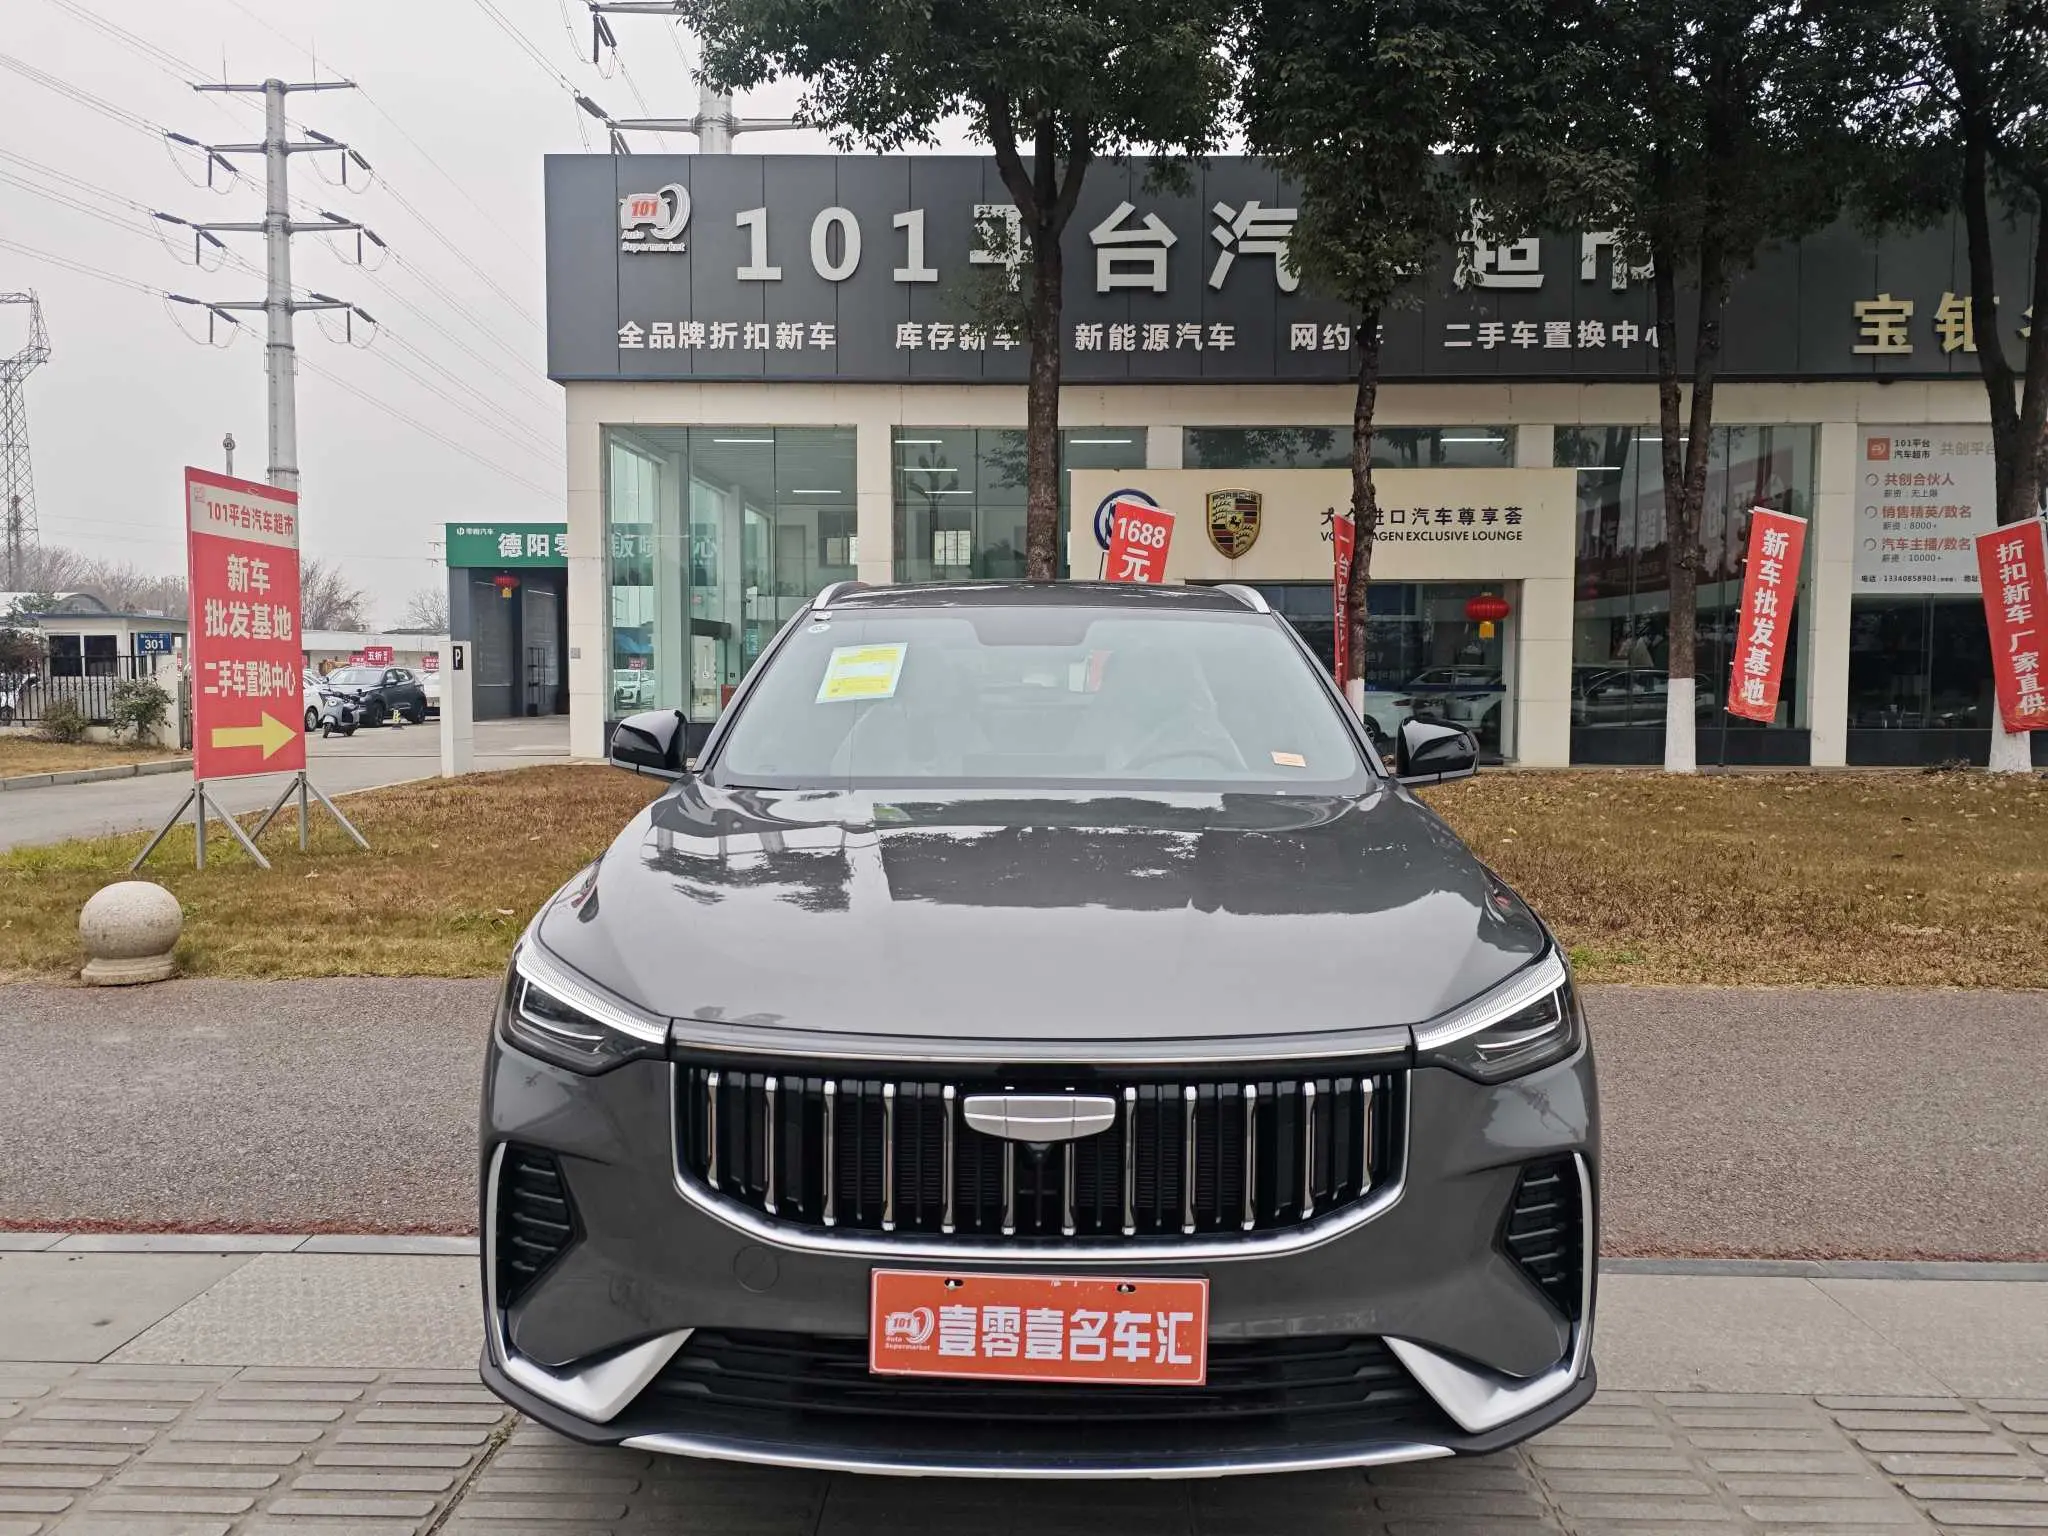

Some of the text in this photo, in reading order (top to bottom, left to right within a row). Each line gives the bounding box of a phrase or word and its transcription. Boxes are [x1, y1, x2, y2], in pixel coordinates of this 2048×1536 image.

[632, 201, 658, 216] 101
[735, 199, 1656, 293] 101平台汽超市
[617, 320, 837, 350] 全品牌折扣新车
[1074, 323, 1237, 351] 新能源汽车
[1884, 472, 1955, 486] 共创合伙人
[1212, 491, 1258, 502] PORSCHE
[207, 501, 294, 537] 101平台汽车超市
[1320, 506, 1523, 526] 大口汽车尊享荟
[1117, 517, 1167, 549] 1688
[1320, 530, 1523, 541] VOAGEN EXCLUSIVE LOUNGE
[227, 553, 271, 596] 新车
[1118, 547, 1151, 582] 元
[204, 598, 293, 642] 批发基地
[1739, 528, 1789, 706] 新车批发基地
[144, 639, 164, 650] 301
[203, 660, 296, 698] 二手车置换中心
[893, 1316, 912, 1328] 101
[938, 1304, 1194, 1365] 壹零壹名车汇
